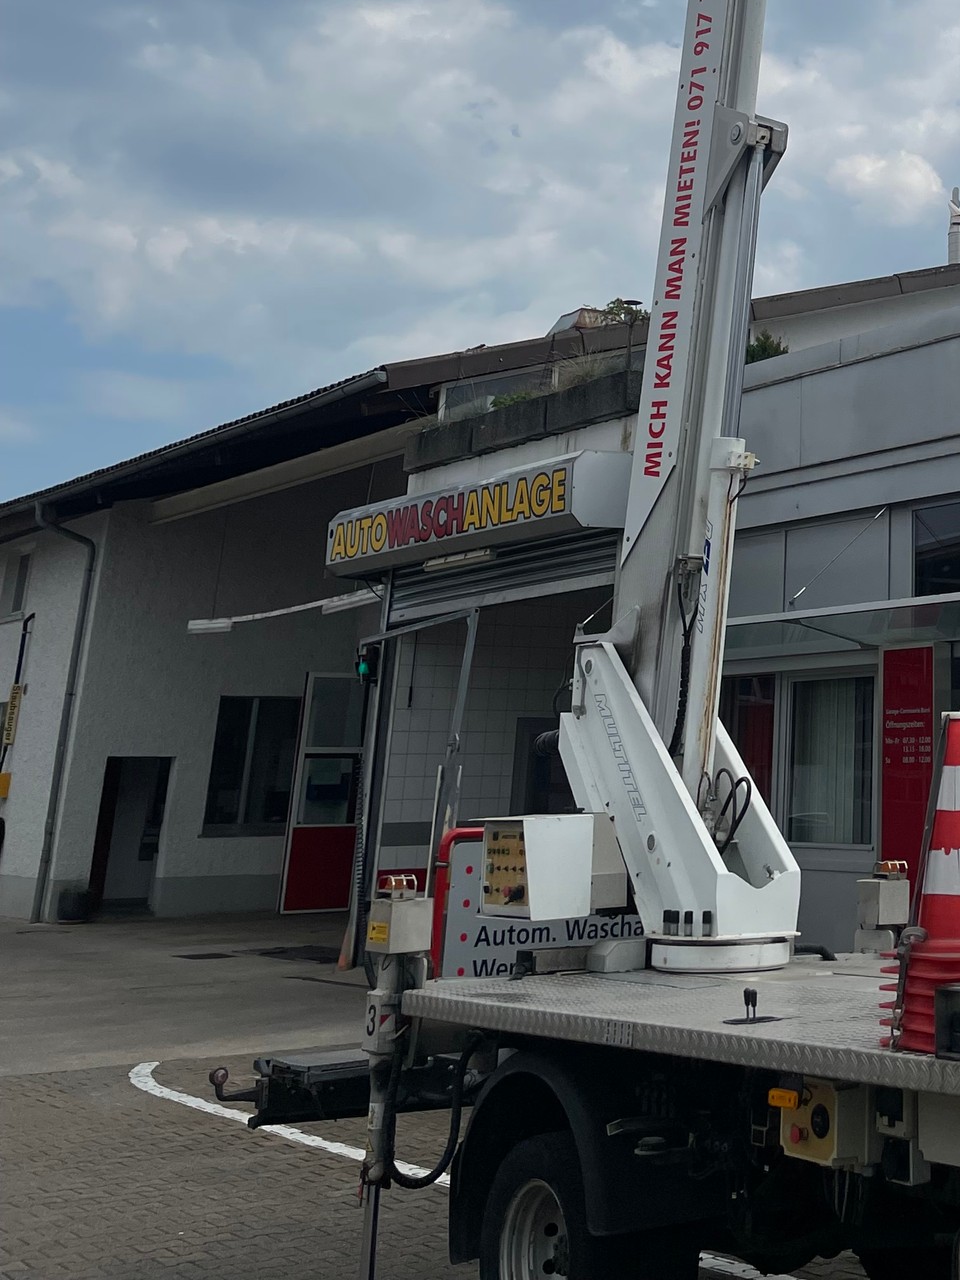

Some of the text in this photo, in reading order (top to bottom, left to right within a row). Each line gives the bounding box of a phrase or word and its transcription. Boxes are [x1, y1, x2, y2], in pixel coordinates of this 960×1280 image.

[693, 12, 713, 56] 917
[687, 66, 707, 111] 071
[673, 119, 701, 227] MIETEN!
[664, 237, 687, 300] MAN
[653, 311, 679, 388] KANN
[644, 400, 668, 477] MICH
[329, 468, 567, 561] AUTOWASCHANLAGE
[5, 685, 21, 741] Staubsauger
[594, 693, 647, 822] MULTITEL
[473, 924, 557, 948] Autom.
[366, 1004, 377, 1037] 3
